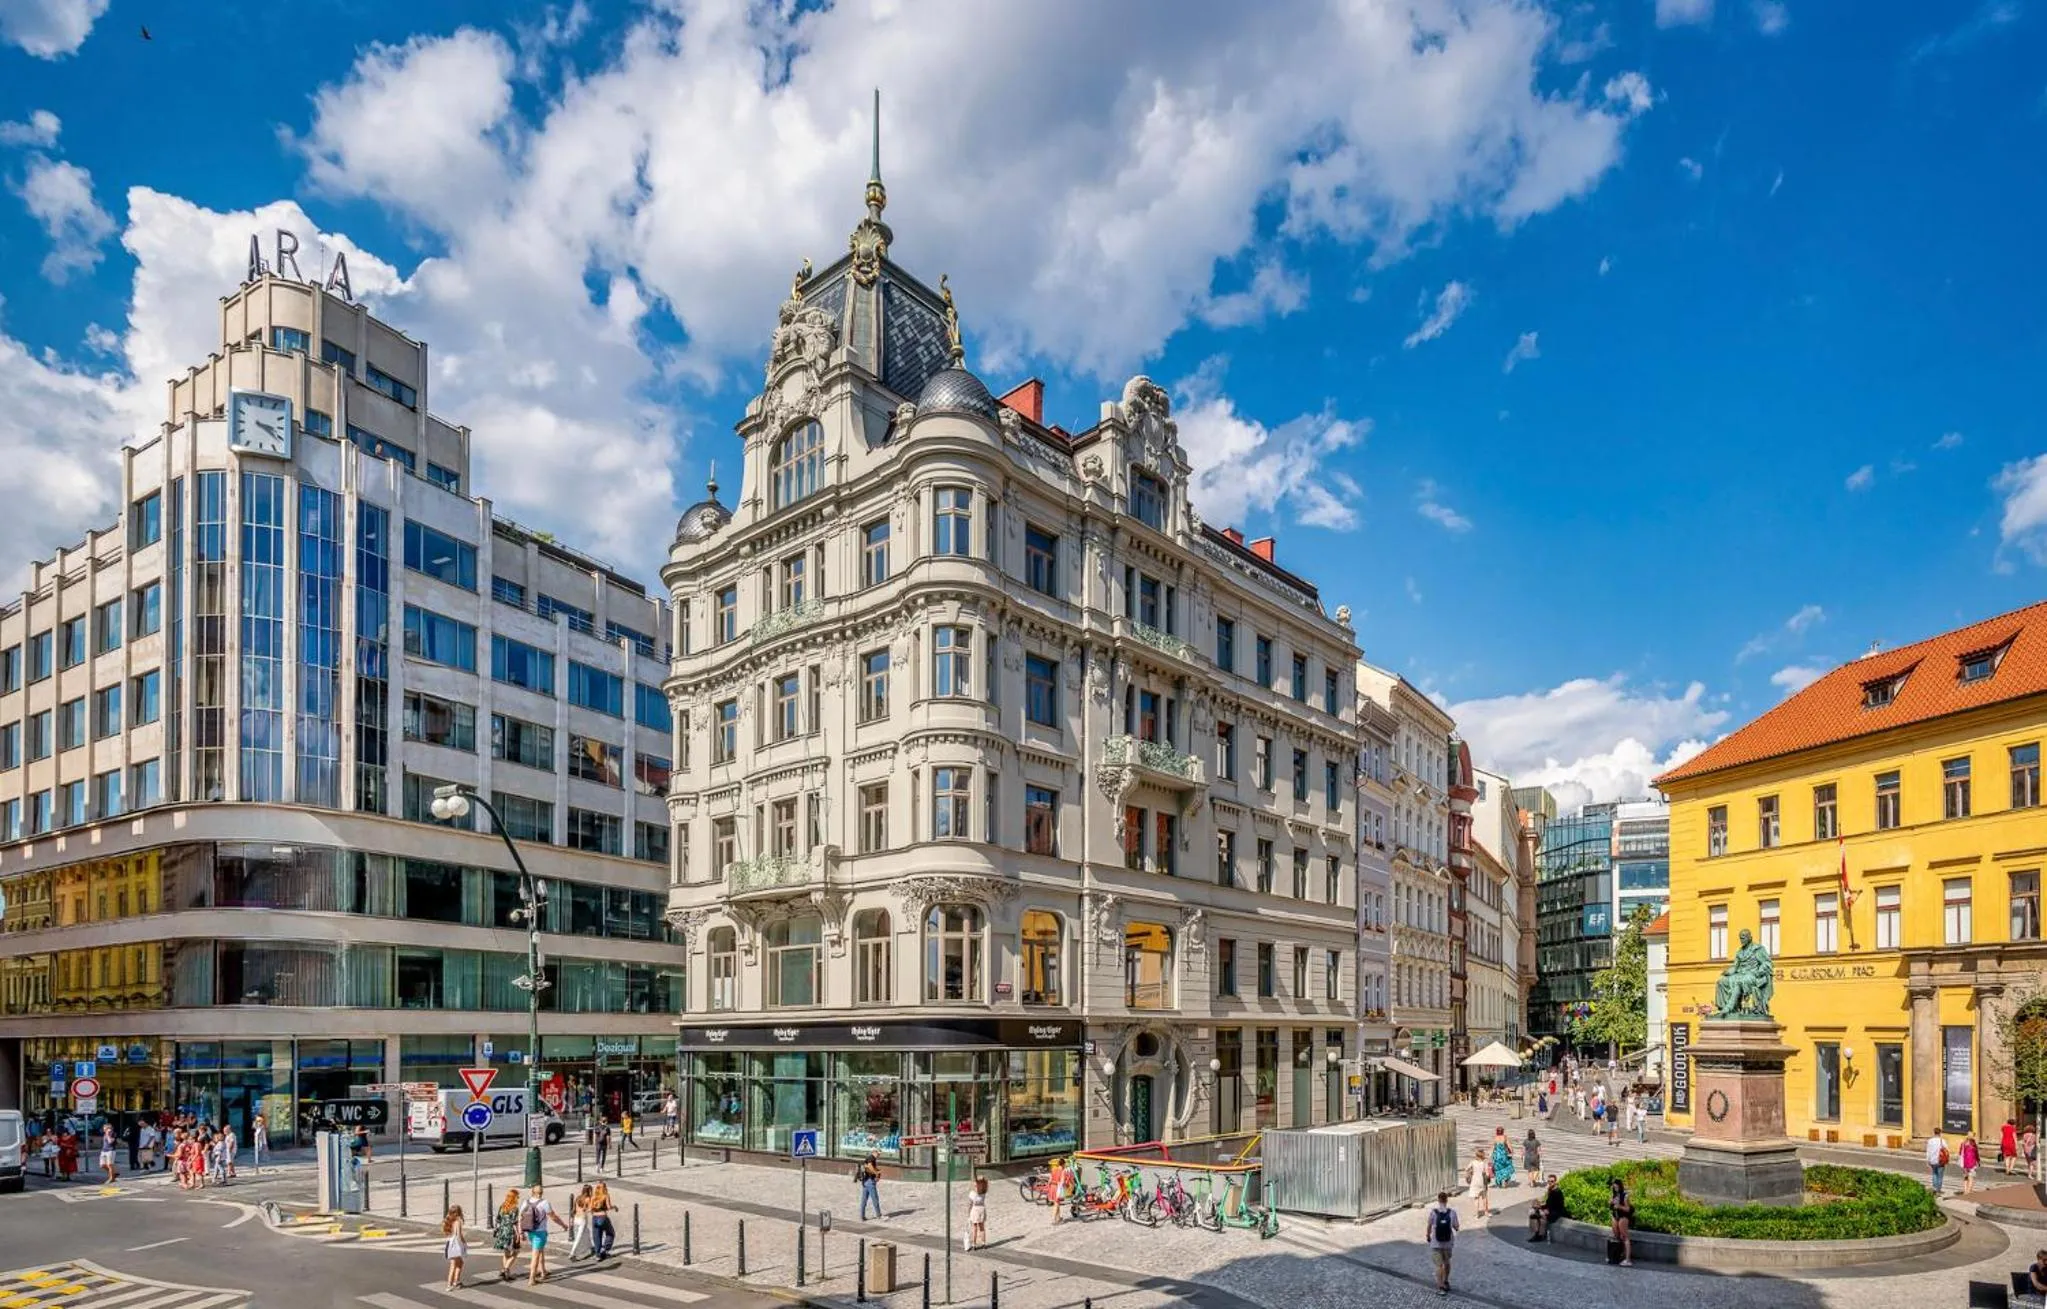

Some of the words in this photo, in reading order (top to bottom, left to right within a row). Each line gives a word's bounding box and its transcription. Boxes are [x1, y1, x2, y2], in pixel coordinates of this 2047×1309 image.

[248, 229, 353, 301] ARA
[1589, 913, 1606, 927] EF
[55, 1064, 64, 1075] P
[492, 1095, 523, 1114] GLS
[341, 1105, 362, 1121] WC
